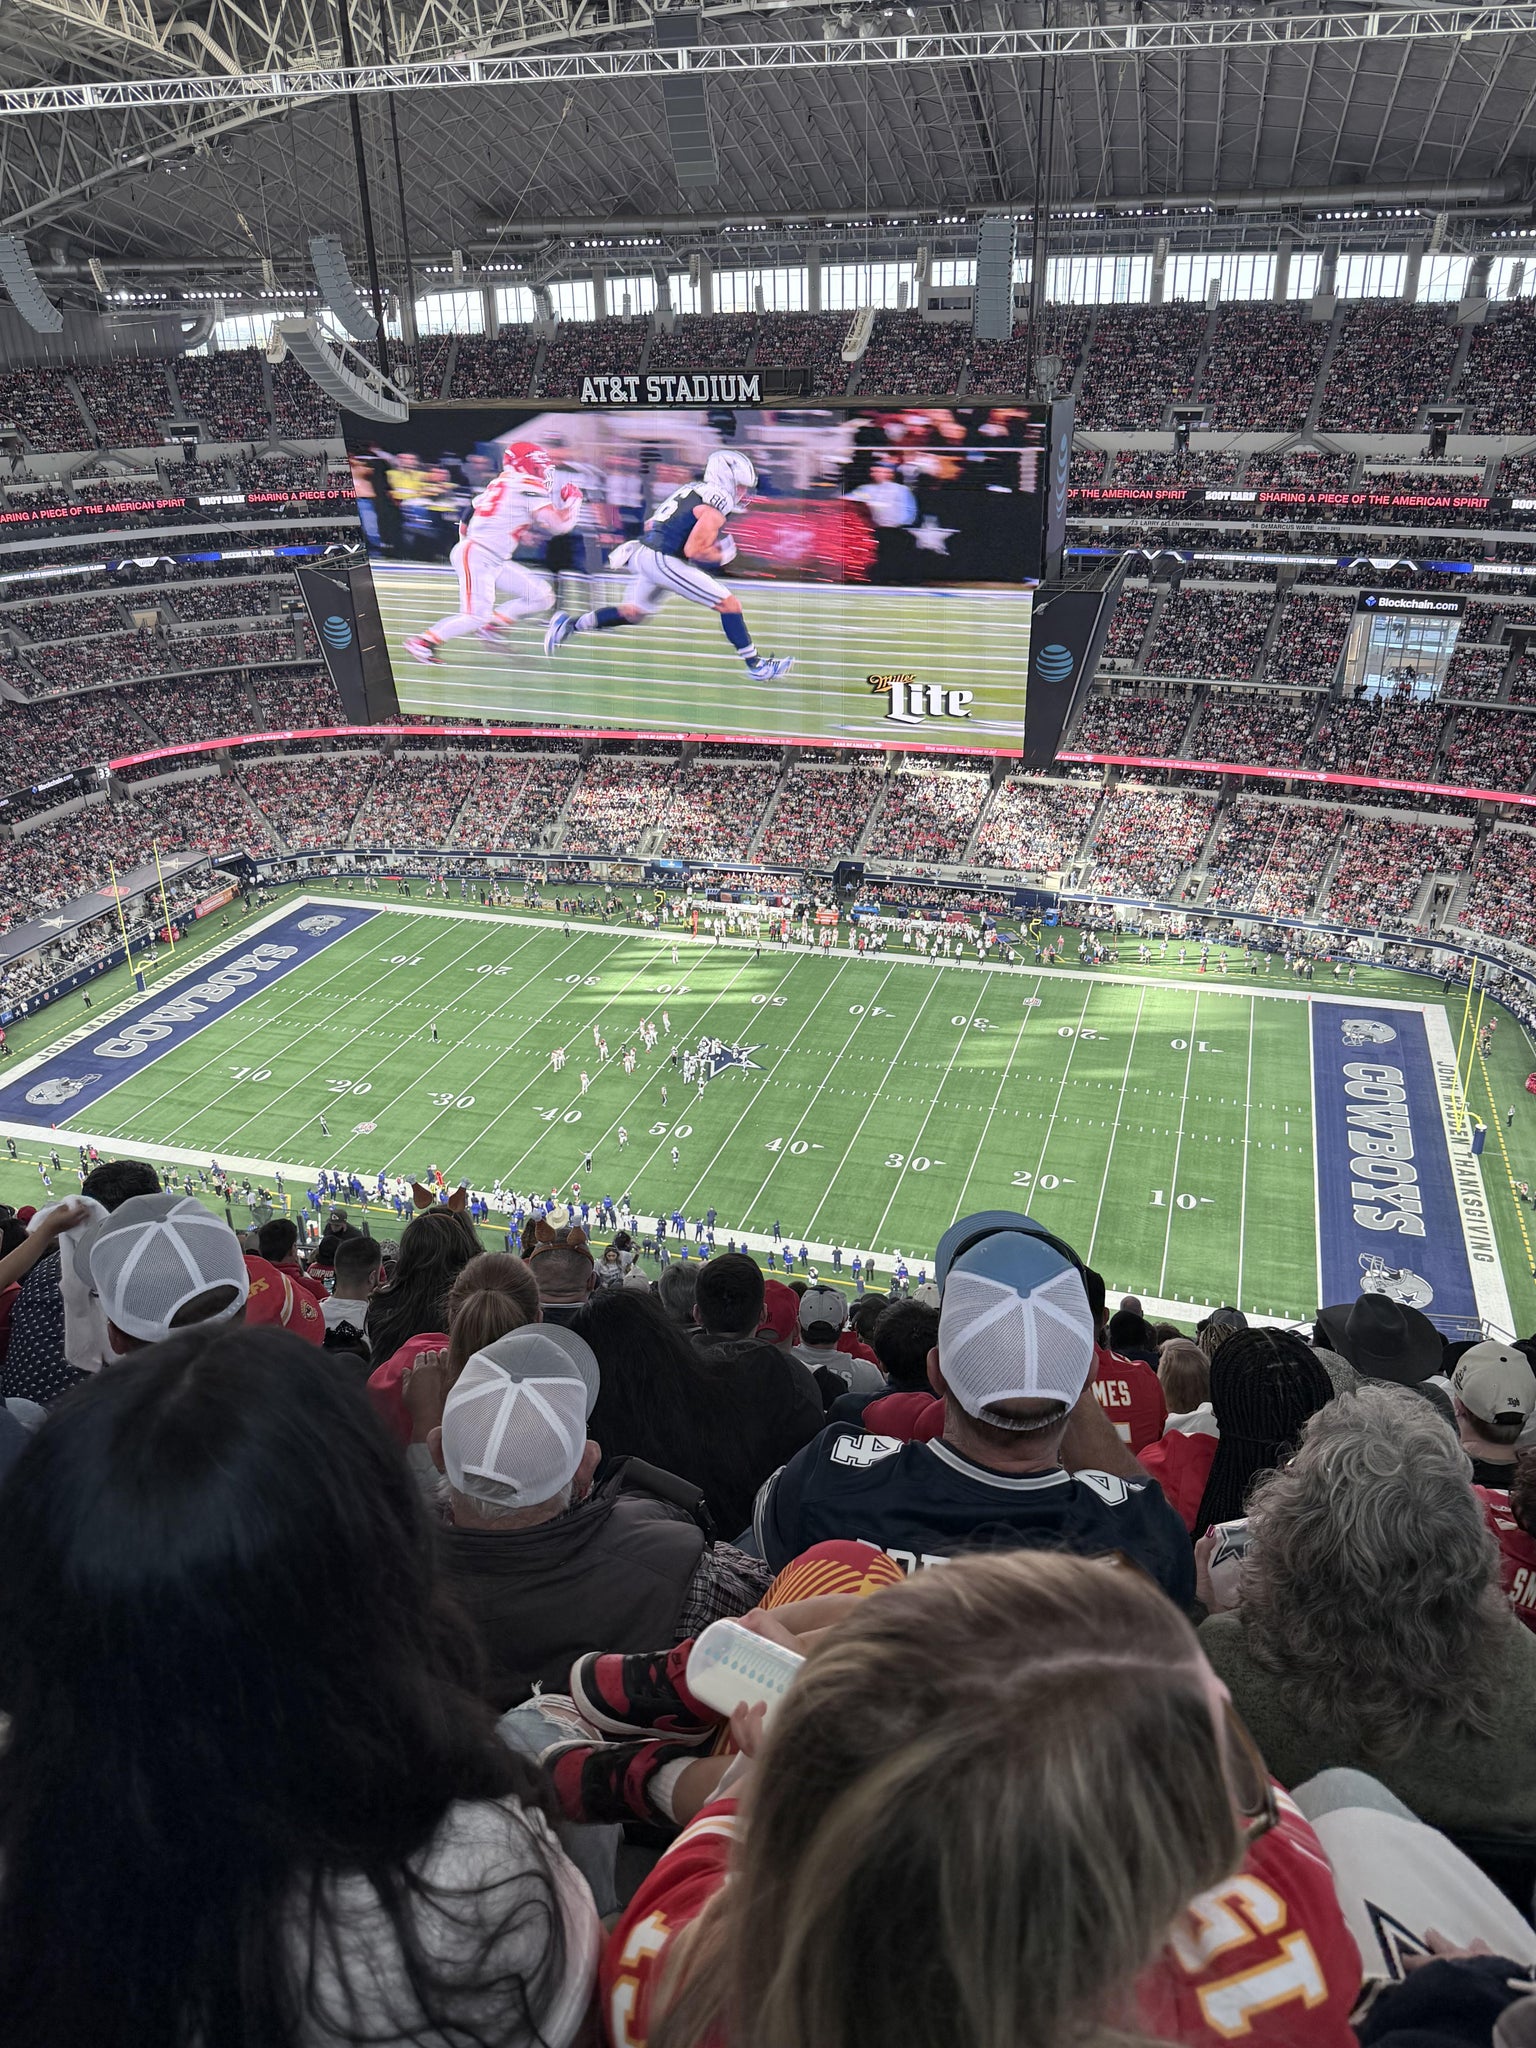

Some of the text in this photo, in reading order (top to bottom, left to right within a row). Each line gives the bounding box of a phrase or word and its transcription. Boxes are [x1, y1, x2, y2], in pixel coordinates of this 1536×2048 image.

[580, 375, 761, 403] AT&T STADIUM
[248, 493, 289, 503] SHARING
[290, 492, 298, 501] A
[299, 491, 326, 500] PIECE
[327, 490, 340, 499] OF
[1080, 489, 1099, 498] THE
[1101, 490, 1153, 499] AMERICAN
[1155, 491, 1188, 500] SPIRIT
[1259, 492, 1490, 508] SHARING A PIECE OF THE AMERICAN SPIRIT
[31, 511, 39, 521] A
[40, 508, 68, 520] PIECE
[69, 506, 82, 517] OF
[84, 505, 103, 515] THE
[105, 501, 154, 512] AMERICAN
[156, 498, 186, 508] SPIRIT
[1378, 597, 1459, 611] Blockchain.com
[869, 673, 917, 693] Miller
[886, 682, 974, 724] Lite
[476, 963, 513, 976] 20
[565, 973, 601, 986] 30
[37, 1034, 77, 1062] JOHN
[83, 990, 150, 1032] MADDEN
[152, 932, 252, 991] THANKSGIVING
[92, 943, 299, 1059] COWBOYS
[751, 994, 788, 1007] 50
[230, 1066, 273, 1082] 10
[327, 1079, 373, 1096] 20
[432, 1092, 476, 1109] 30
[539, 1107, 583, 1124] 40
[648, 1121, 693, 1138] 50
[764, 1136, 809, 1155] 40
[1342, 1062, 1427, 1237] COWBOYS
[884, 1152, 931, 1172] 30
[1437, 1060, 1457, 1090] JOHN
[1453, 1152, 1494, 1263] THANKSGIVING
[1010, 1169, 1061, 1191] 20
[1149, 1189, 1198, 1210] 10
[829, 1433, 906, 1469] 4
